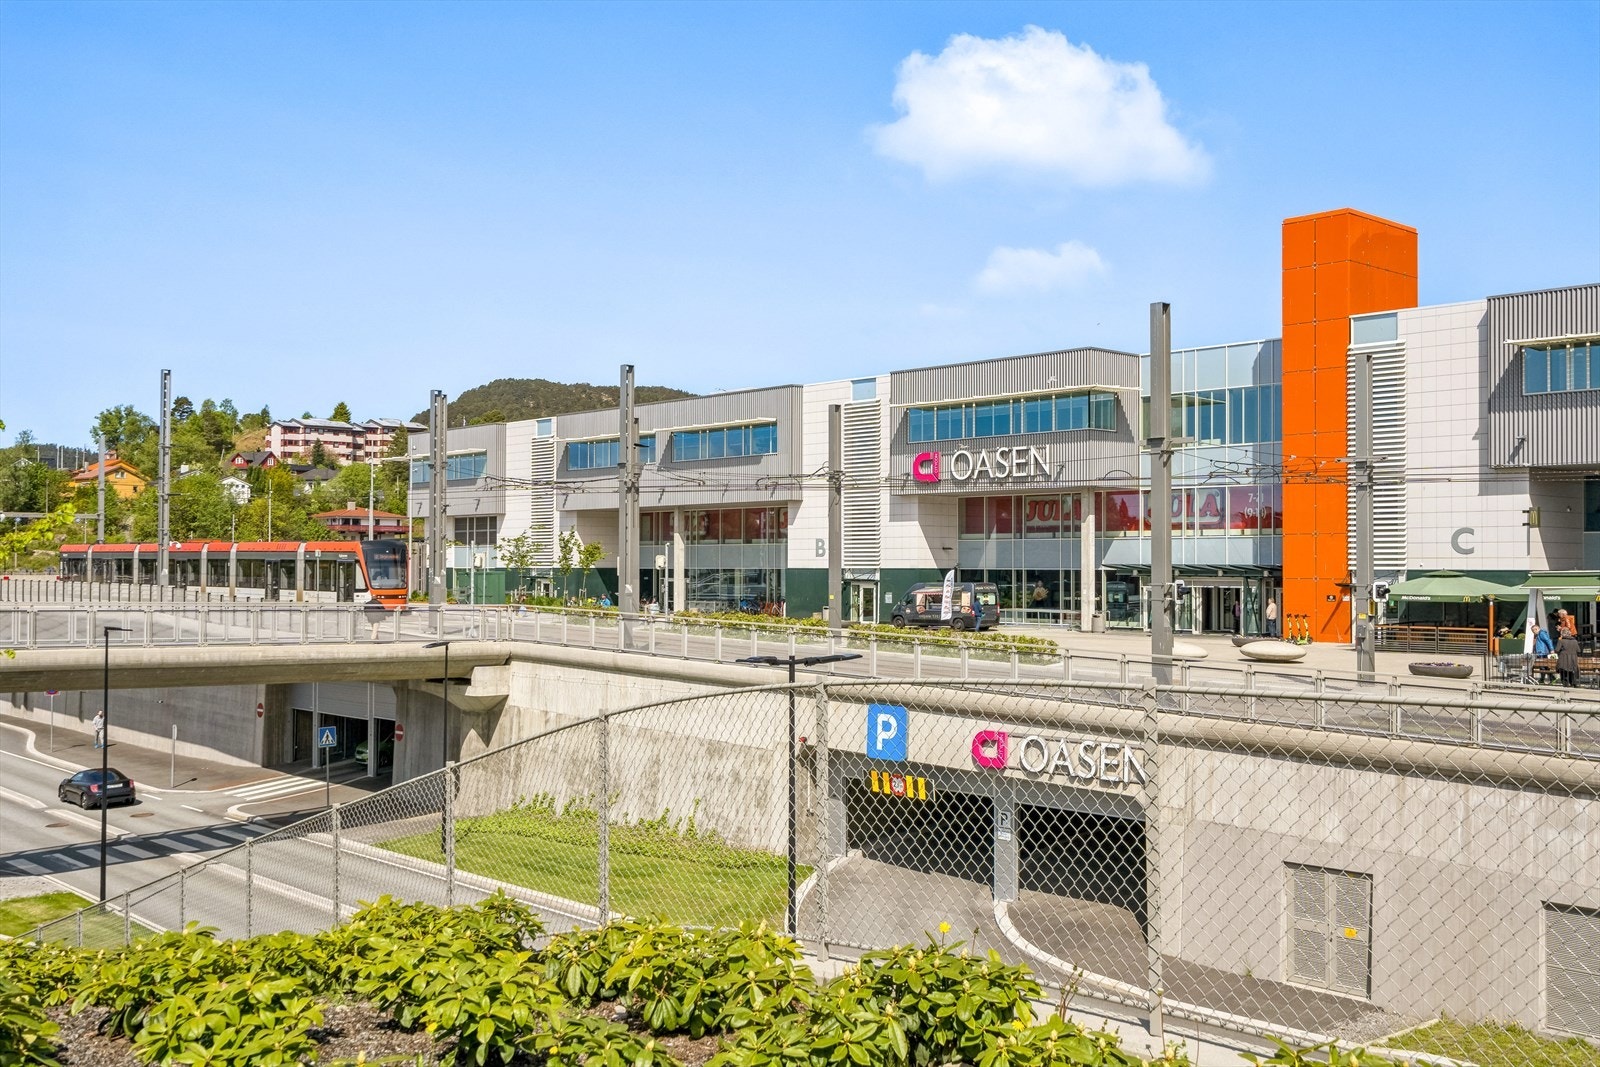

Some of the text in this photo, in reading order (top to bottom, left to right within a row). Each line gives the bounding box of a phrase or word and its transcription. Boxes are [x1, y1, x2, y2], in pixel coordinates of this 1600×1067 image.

[951, 444, 1050, 480] OASEN
[815, 538, 826, 557] B
[1451, 527, 1474, 555] C
[876, 713, 898, 750] P
[1020, 735, 1147, 784] OASEN
